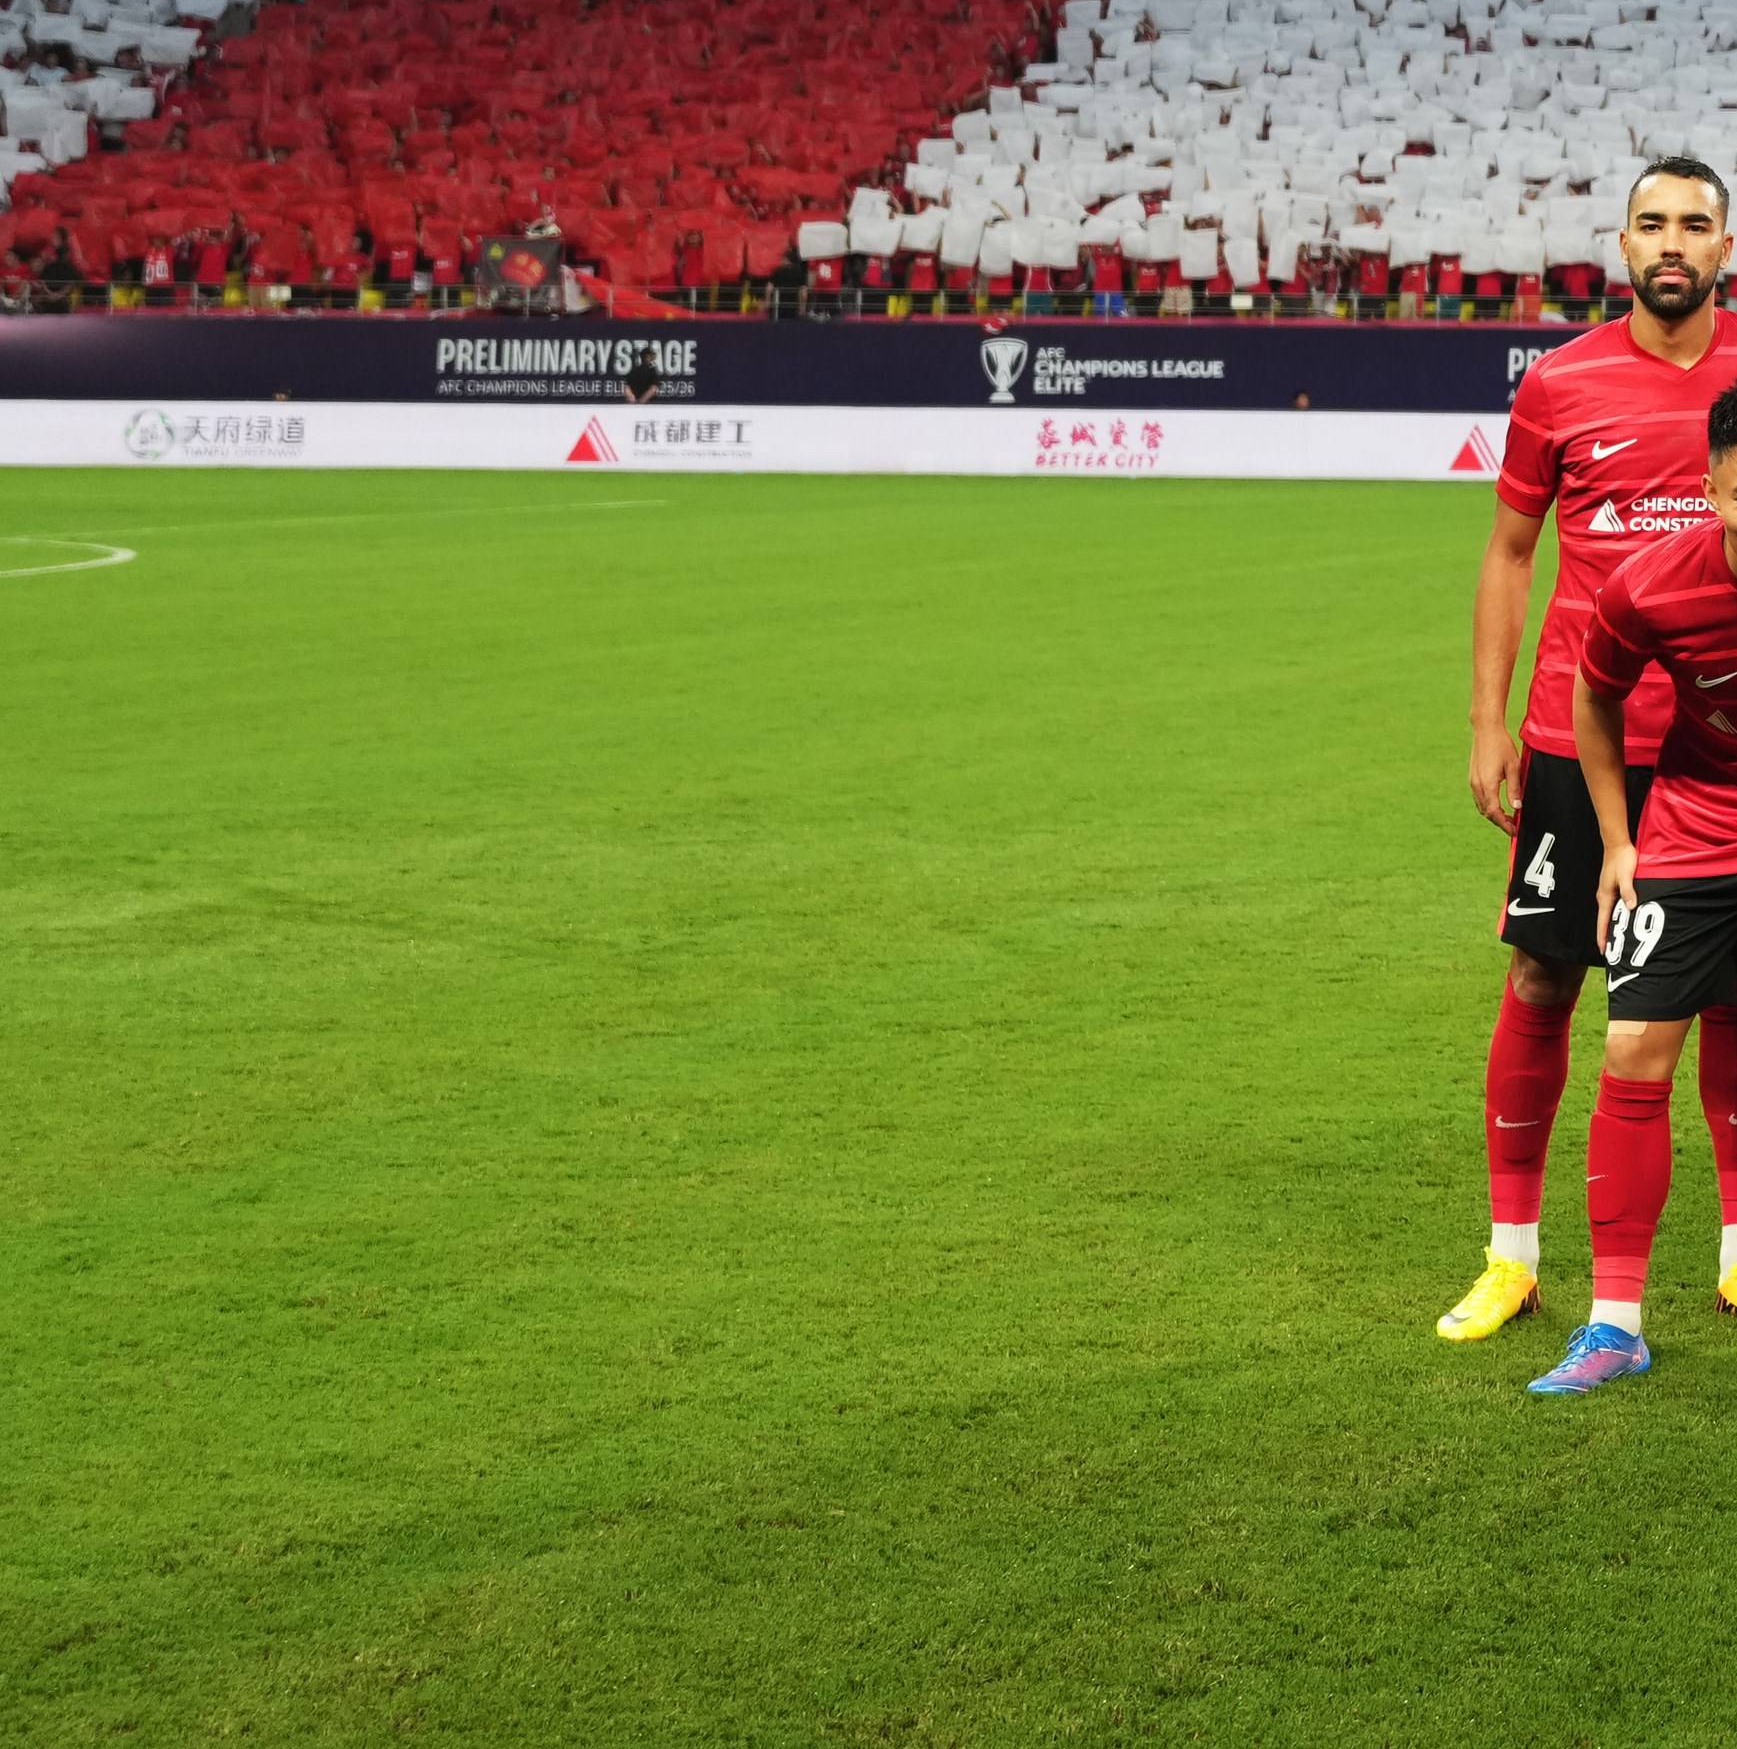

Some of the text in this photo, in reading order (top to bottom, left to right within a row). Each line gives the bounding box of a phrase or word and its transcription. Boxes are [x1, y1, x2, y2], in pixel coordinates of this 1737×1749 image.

[436, 338, 611, 375] PRELIMINARY
[1036, 347, 1066, 359] AFC
[1033, 360, 1226, 378] CHAMPIONS LEAGUE
[438, 379, 463, 395] AFC
[467, 379, 549, 396] CHAMPIONS
[551, 380, 602, 396] LEAGUE
[1033, 377, 1087, 395] ELITE
[183, 415, 305, 445] 天府绿道
[634, 419, 753, 444] 成都建工
[1035, 453, 1160, 468] BETTER CITY
[1523, 832, 1557, 899] 4
[1606, 900, 1666, 968] 39
